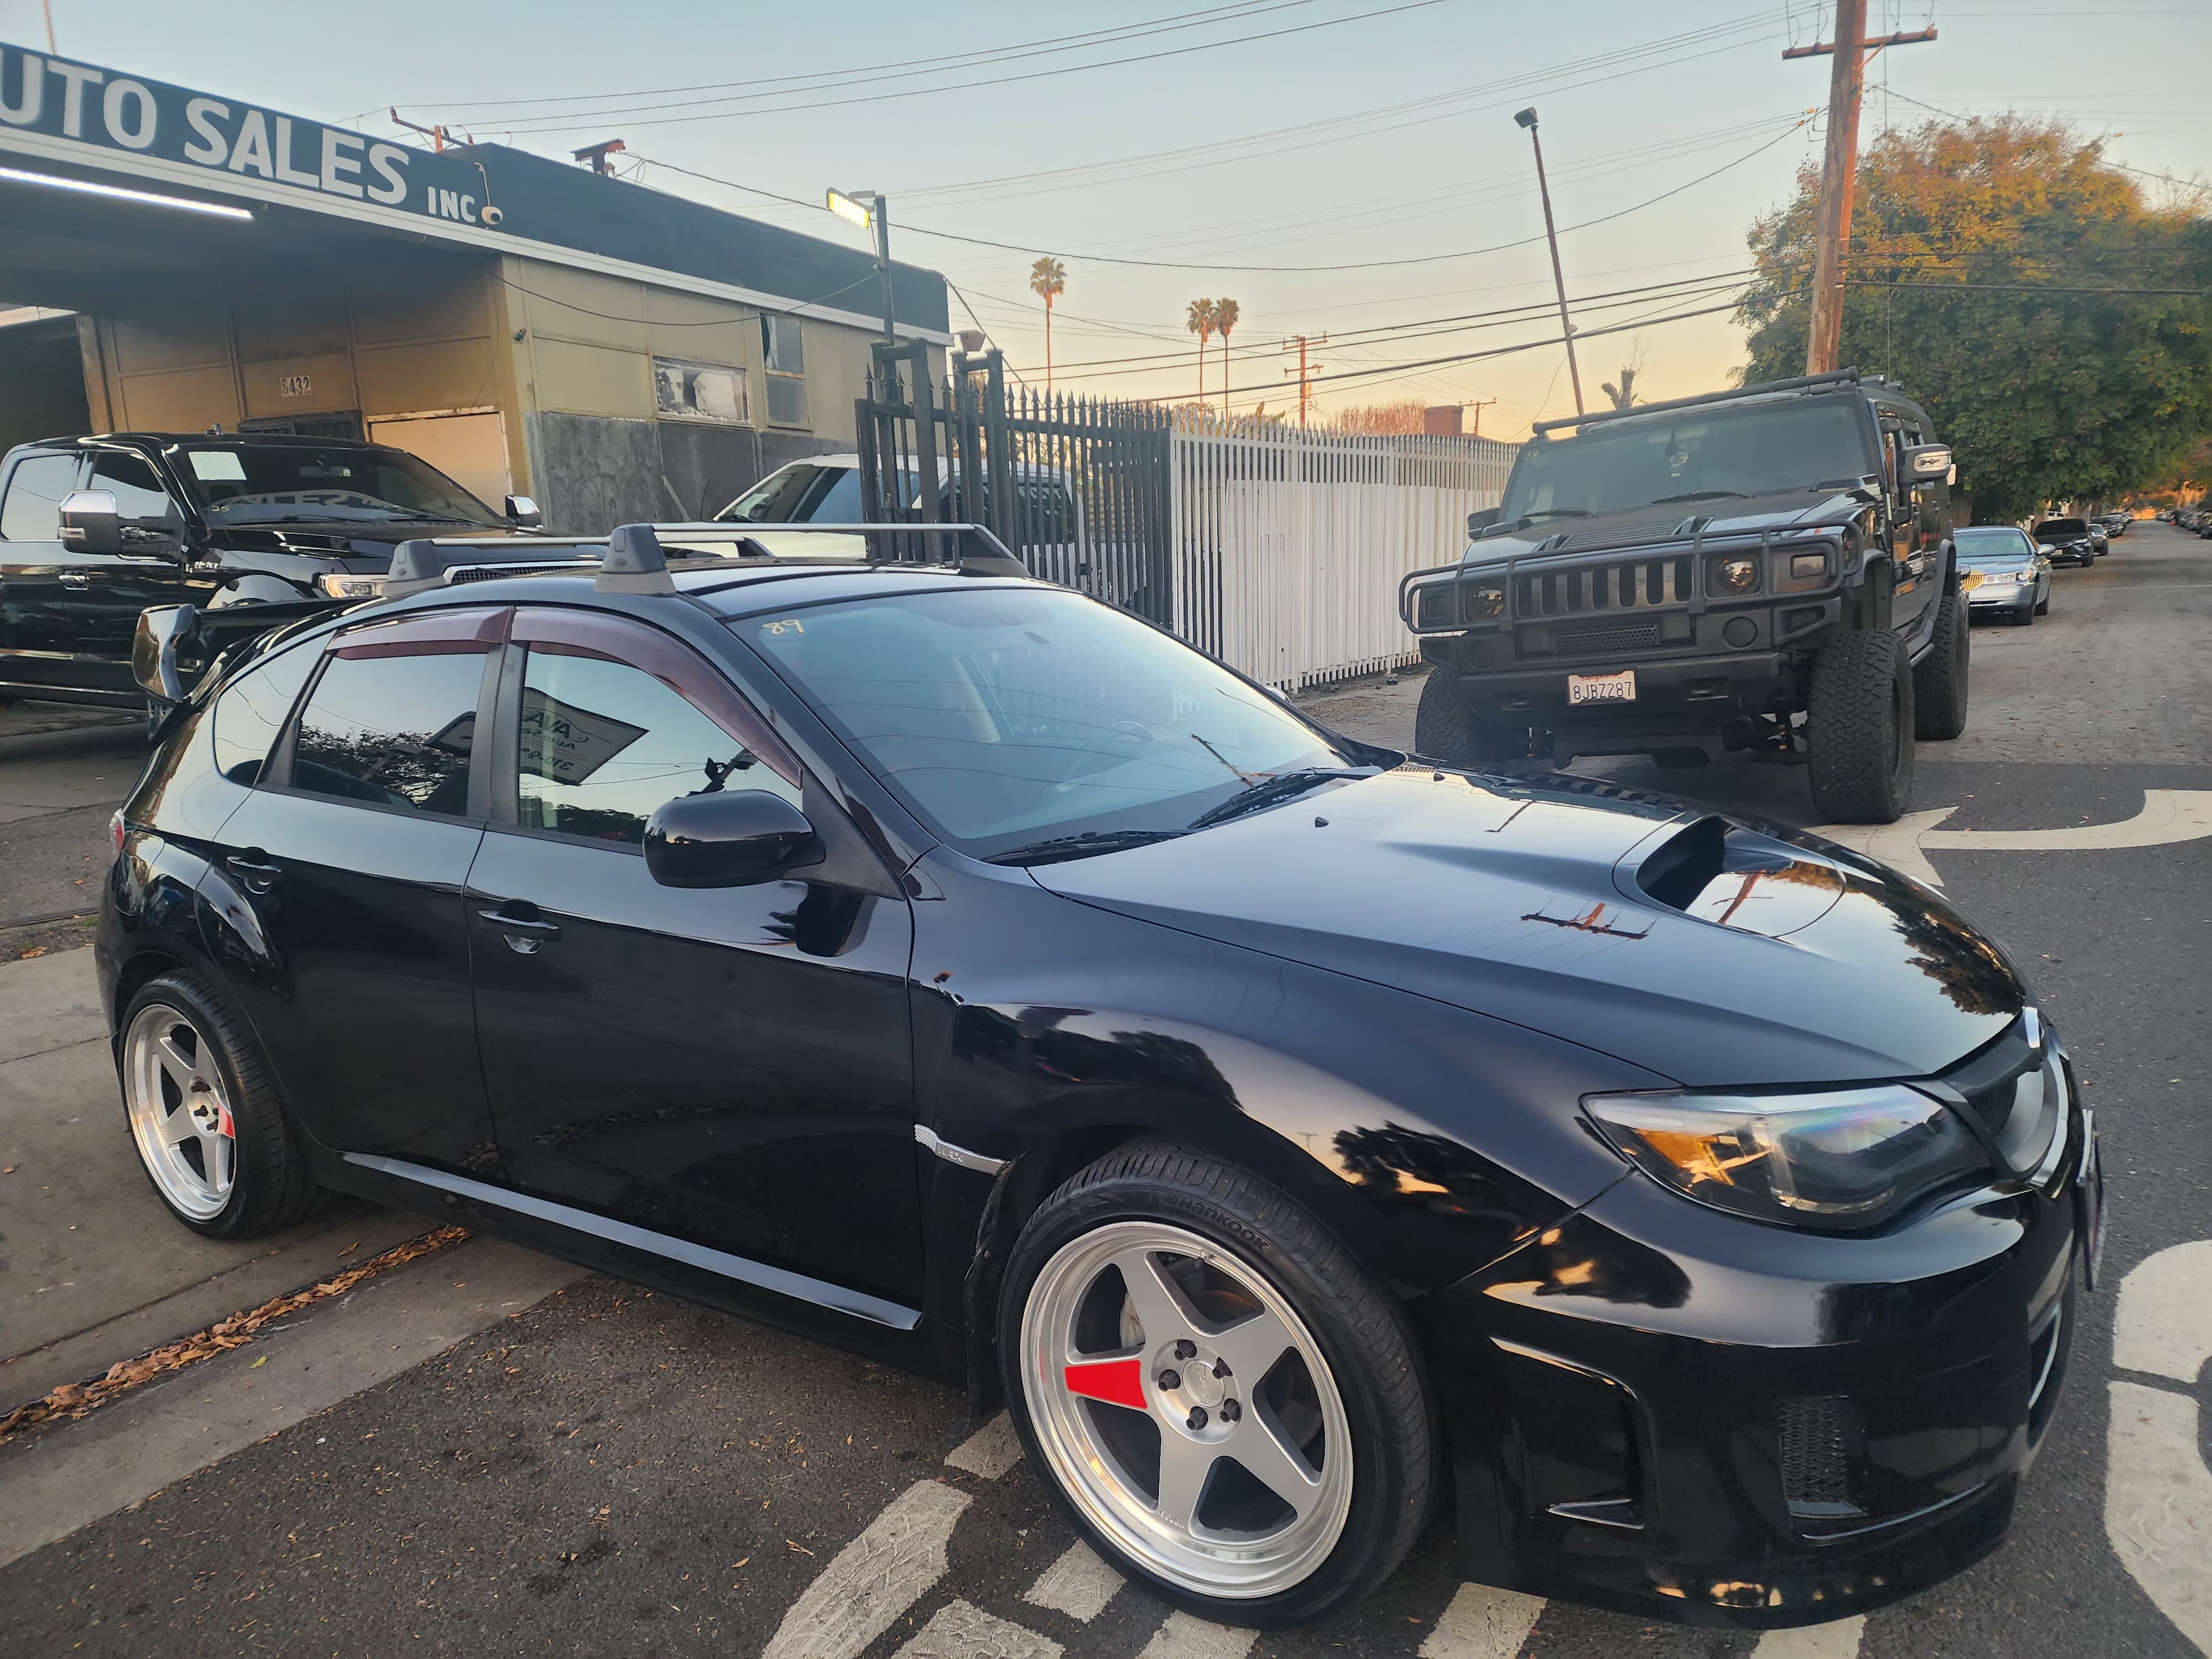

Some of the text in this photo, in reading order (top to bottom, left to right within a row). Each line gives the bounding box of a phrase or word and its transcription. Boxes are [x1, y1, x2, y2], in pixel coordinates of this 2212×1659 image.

[0, 49, 476, 222] UTO SALES INC
[762, 619, 804, 635] 89
[1573, 681, 1631, 700] 8JBZ287
